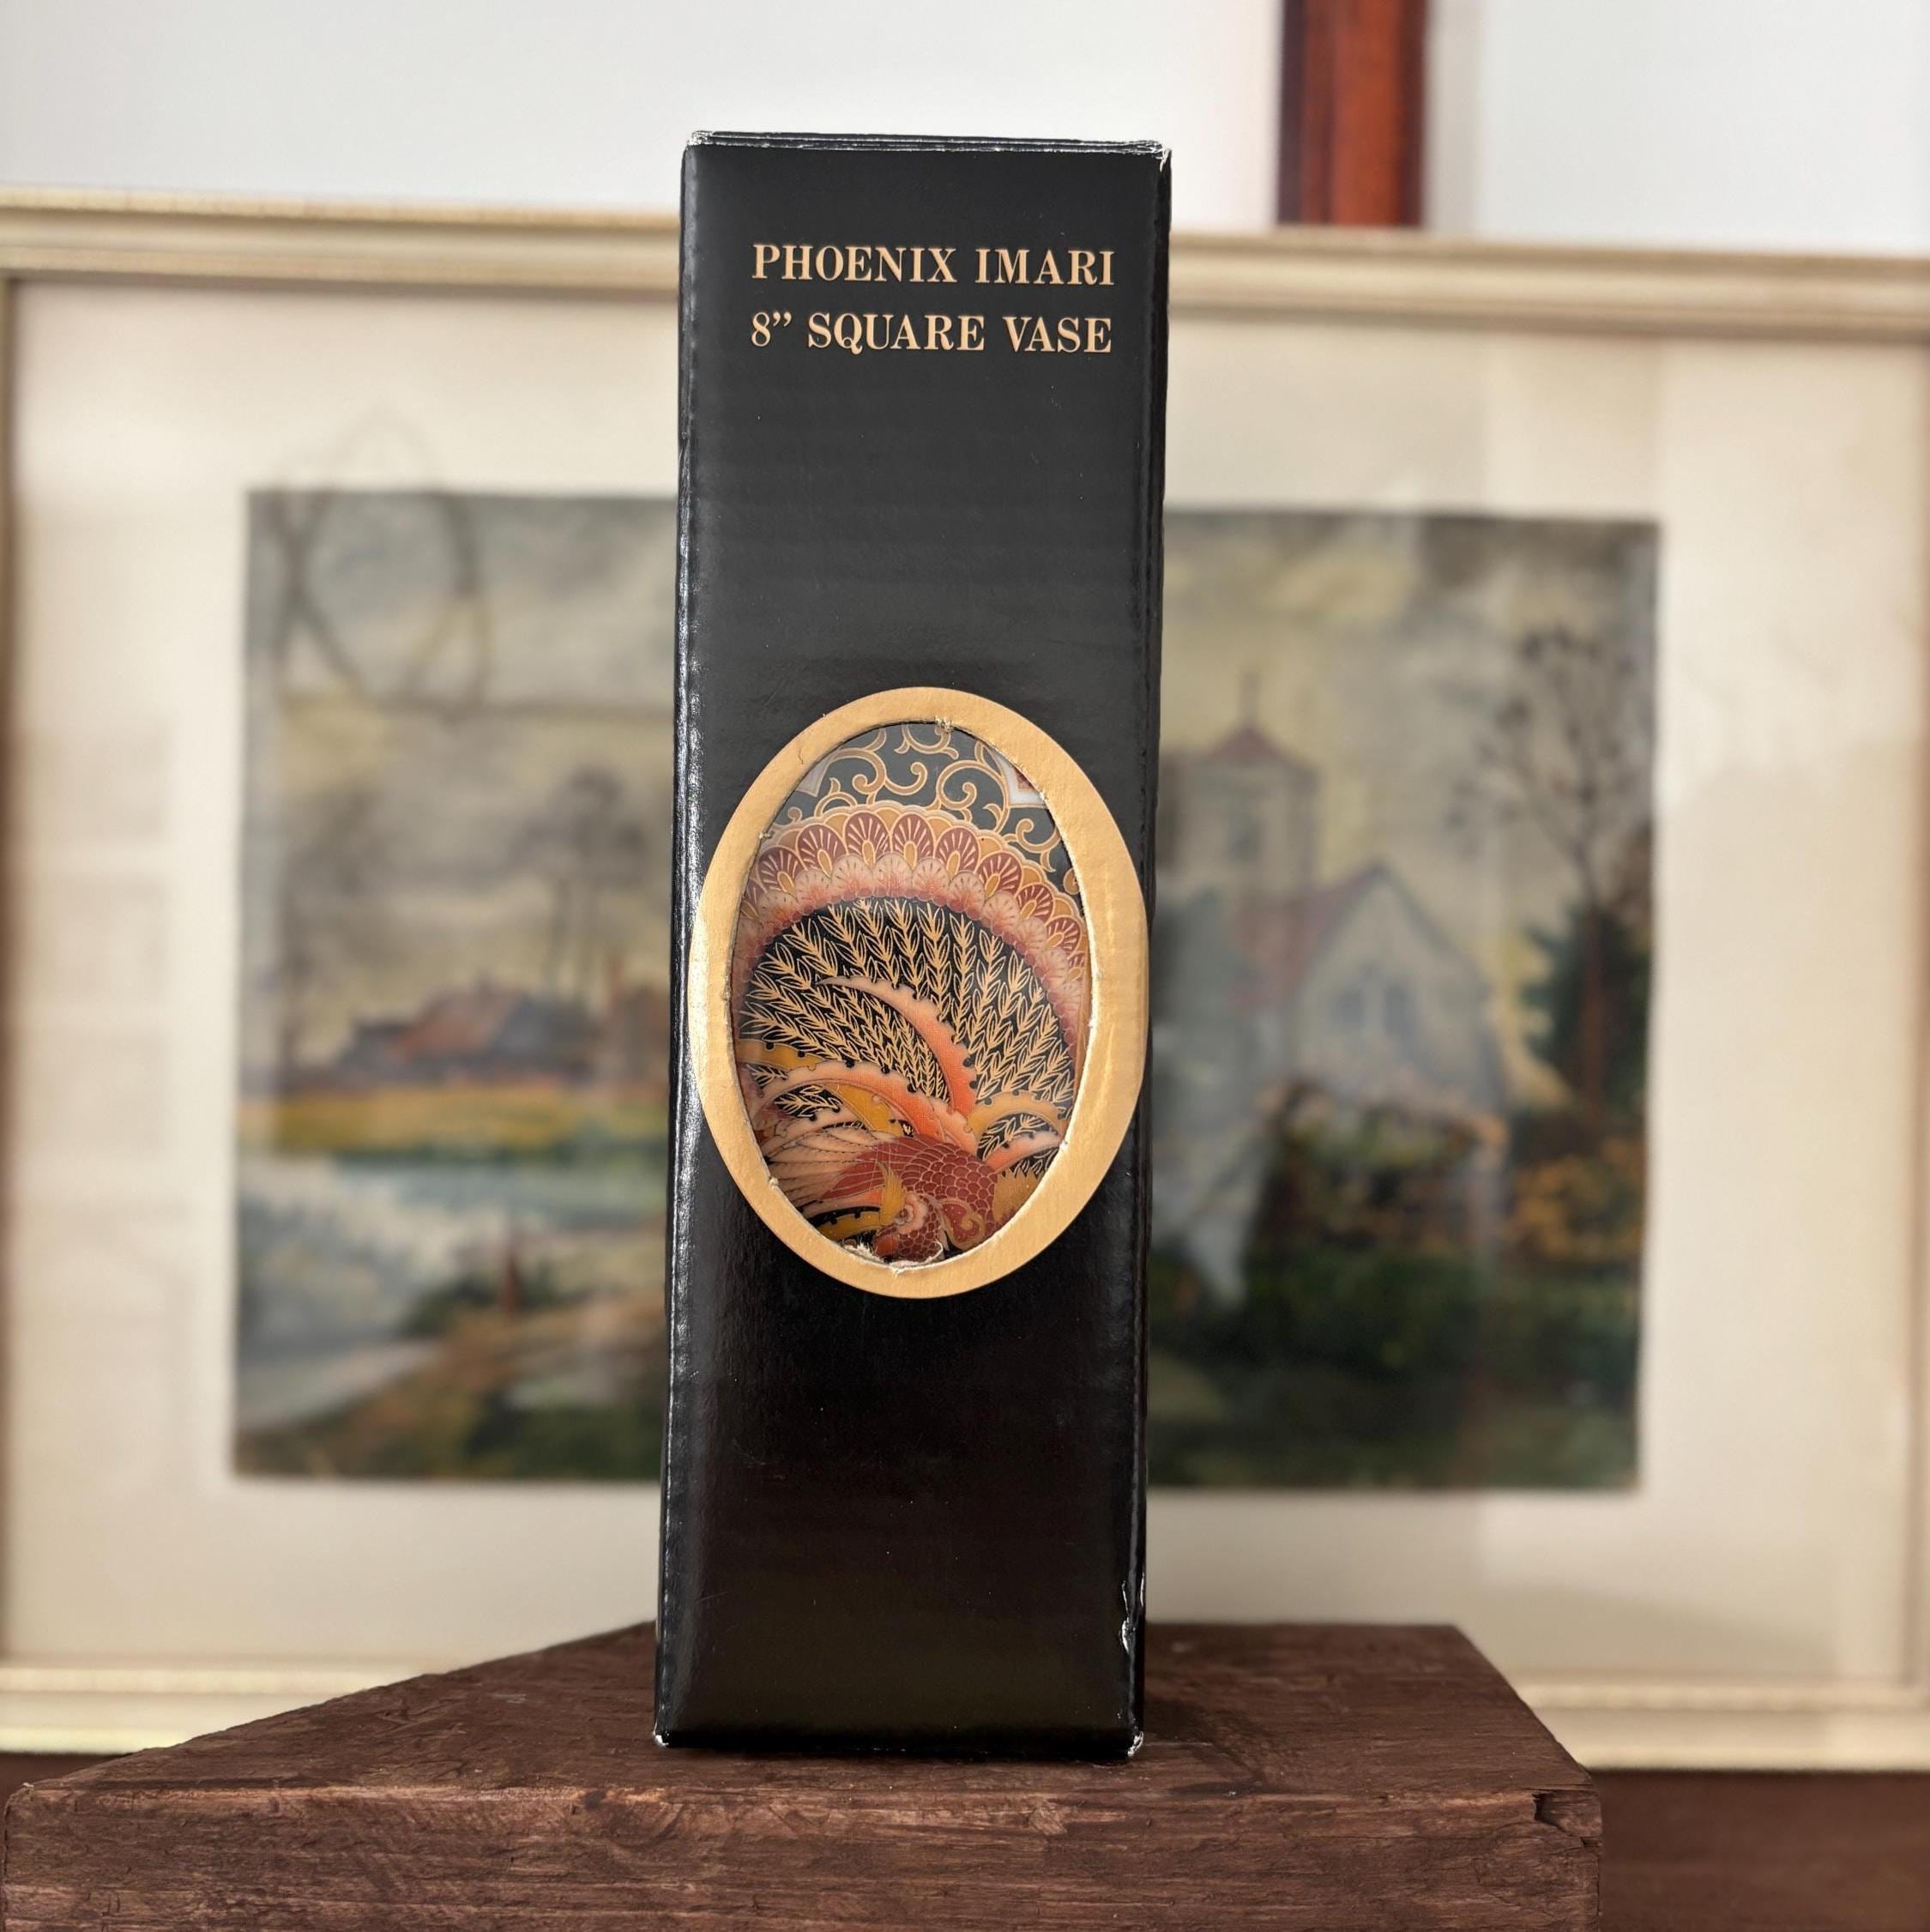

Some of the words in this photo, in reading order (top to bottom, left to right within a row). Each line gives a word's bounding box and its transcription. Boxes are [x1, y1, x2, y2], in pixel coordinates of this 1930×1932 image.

[751, 243, 958, 283] PHOENIX
[974, 248, 1114, 286] IMARI
[808, 311, 985, 355] SQUARE
[1002, 316, 1112, 353] VASE
